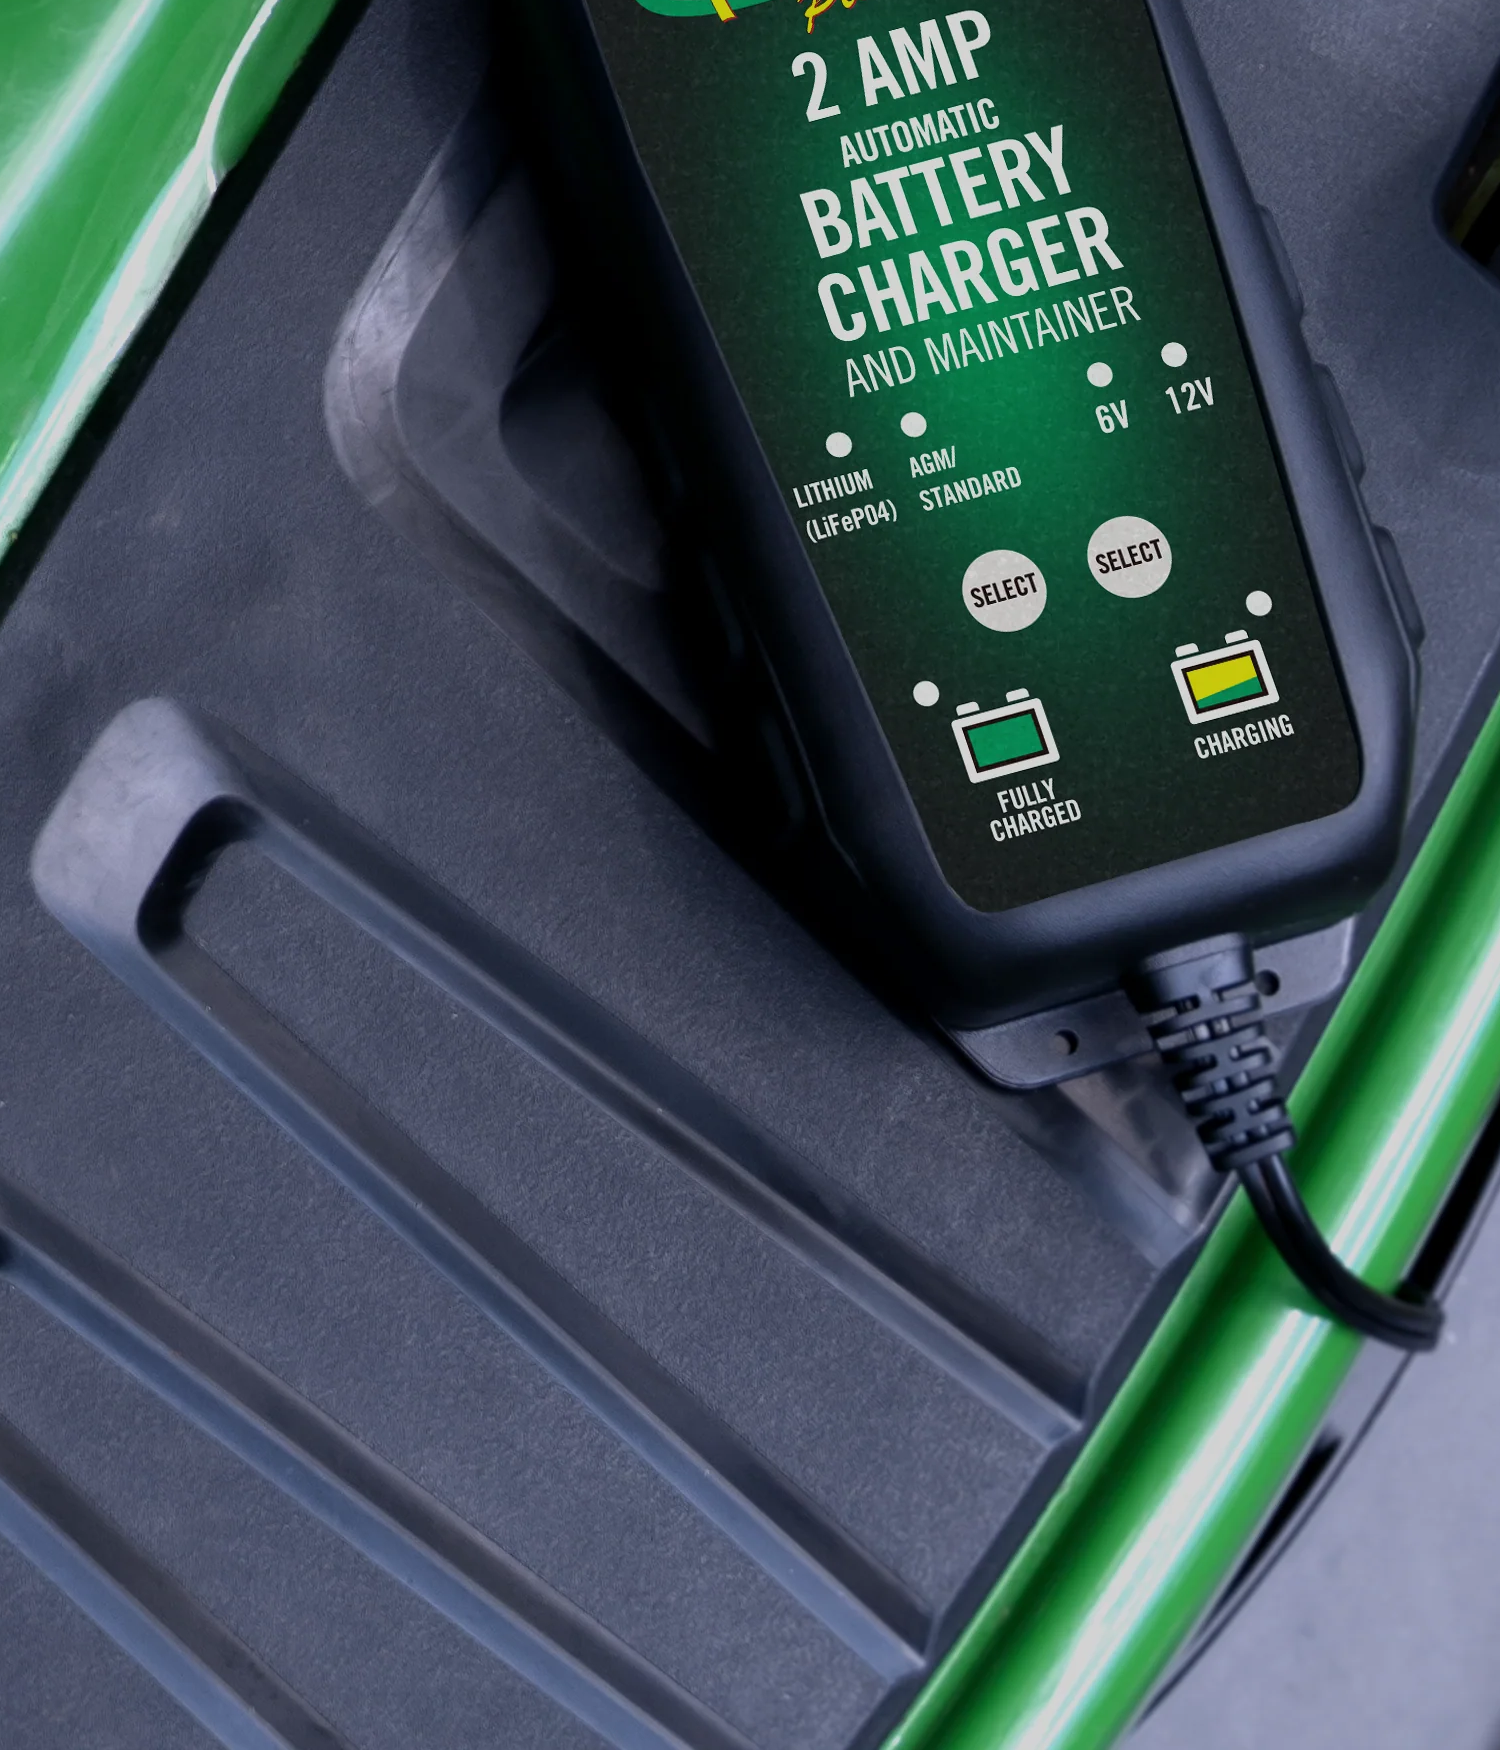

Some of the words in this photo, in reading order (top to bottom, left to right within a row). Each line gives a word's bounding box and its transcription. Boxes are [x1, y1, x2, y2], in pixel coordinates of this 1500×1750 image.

[791, 52, 841, 122] 2
[856, 10, 992, 106] AMP
[839, 98, 1000, 168] AUTOMATIC
[799, 124, 1073, 259] BATTERY
[817, 206, 1124, 342] CHARGER
[845, 345, 916, 397] AND
[925, 285, 1142, 375] MAINTAINER
[1095, 400, 1130, 434] 6V
[1165, 377, 1216, 415] 12V
[908, 446, 957, 479] AGM/
[793, 469, 874, 508] LITHIUM
[919, 467, 1023, 511] STANDARD
[1095, 539, 1164, 575] SELECT
[970, 572, 1039, 609] SELECT
[1193, 714, 1294, 760] CHARGING
[997, 778, 1058, 813] FULLY
[990, 799, 1082, 842] CHARGED
